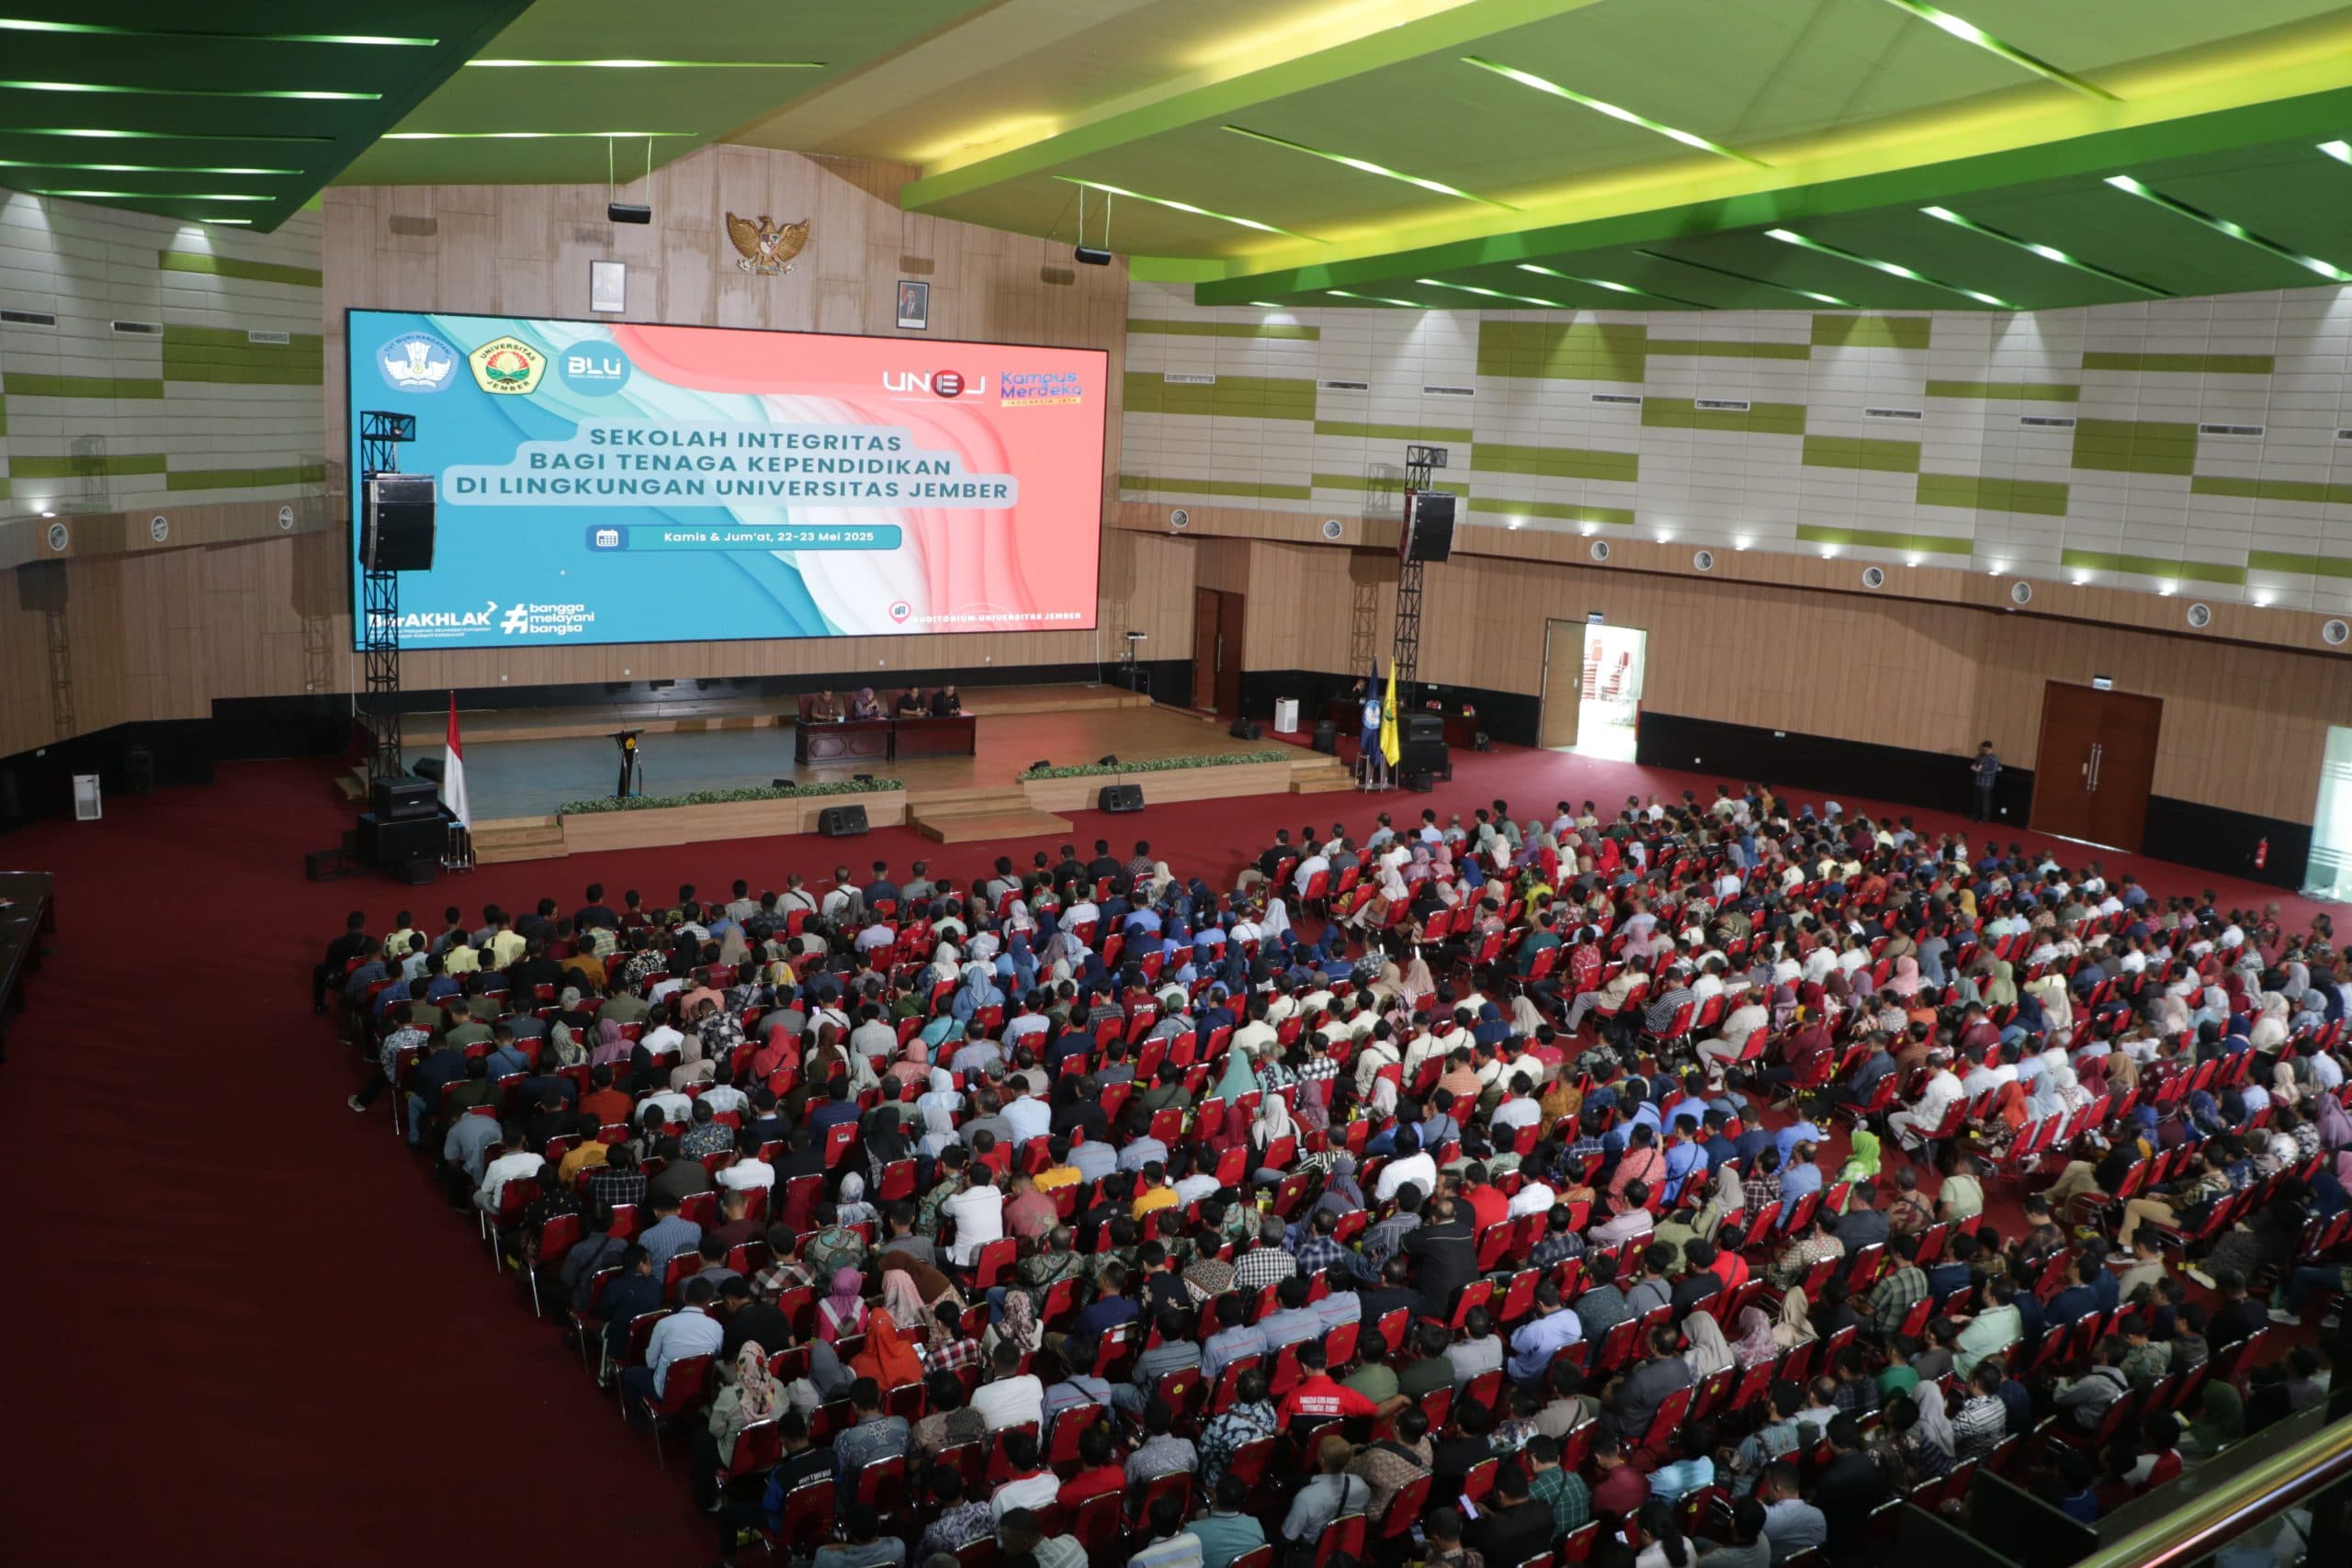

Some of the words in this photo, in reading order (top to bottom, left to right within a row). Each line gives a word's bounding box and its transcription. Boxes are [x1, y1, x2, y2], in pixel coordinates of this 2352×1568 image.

[480, 343, 537, 361] UNIVERSITAS
[568, 355, 621, 375] BLU
[883, 369, 986, 397] UNEJ
[1001, 370, 1077, 384] Kampus
[487, 379, 530, 391] JEMBER
[1001, 384, 1082, 398] Merdeka
[590, 429, 727, 447] SEKOLAH
[738, 432, 901, 451] INTEGRITAS
[530, 452, 605, 470] BAGI
[616, 454, 737, 472] TENAGA
[748, 457, 951, 476] KEPENDIDIKAN
[457, 477, 487, 494] DI
[500, 477, 705, 496] LINGKUNGAN
[717, 479, 899, 497] UNIVERSITAS
[909, 482, 1008, 499] JEMBER
[664, 532, 707, 542] Kamis
[710, 533, 720, 542] &
[777, 532, 815, 541] 22-23
[819, 532, 841, 541] Mei
[844, 532, 875, 541] 2025
[529, 603, 584, 615] bangga
[529, 612, 595, 625] melayani
[978, 614, 1042, 622] UNIVERSITAS
[1045, 612, 1081, 621] JEMBER
[529, 625, 583, 636] bangsa
